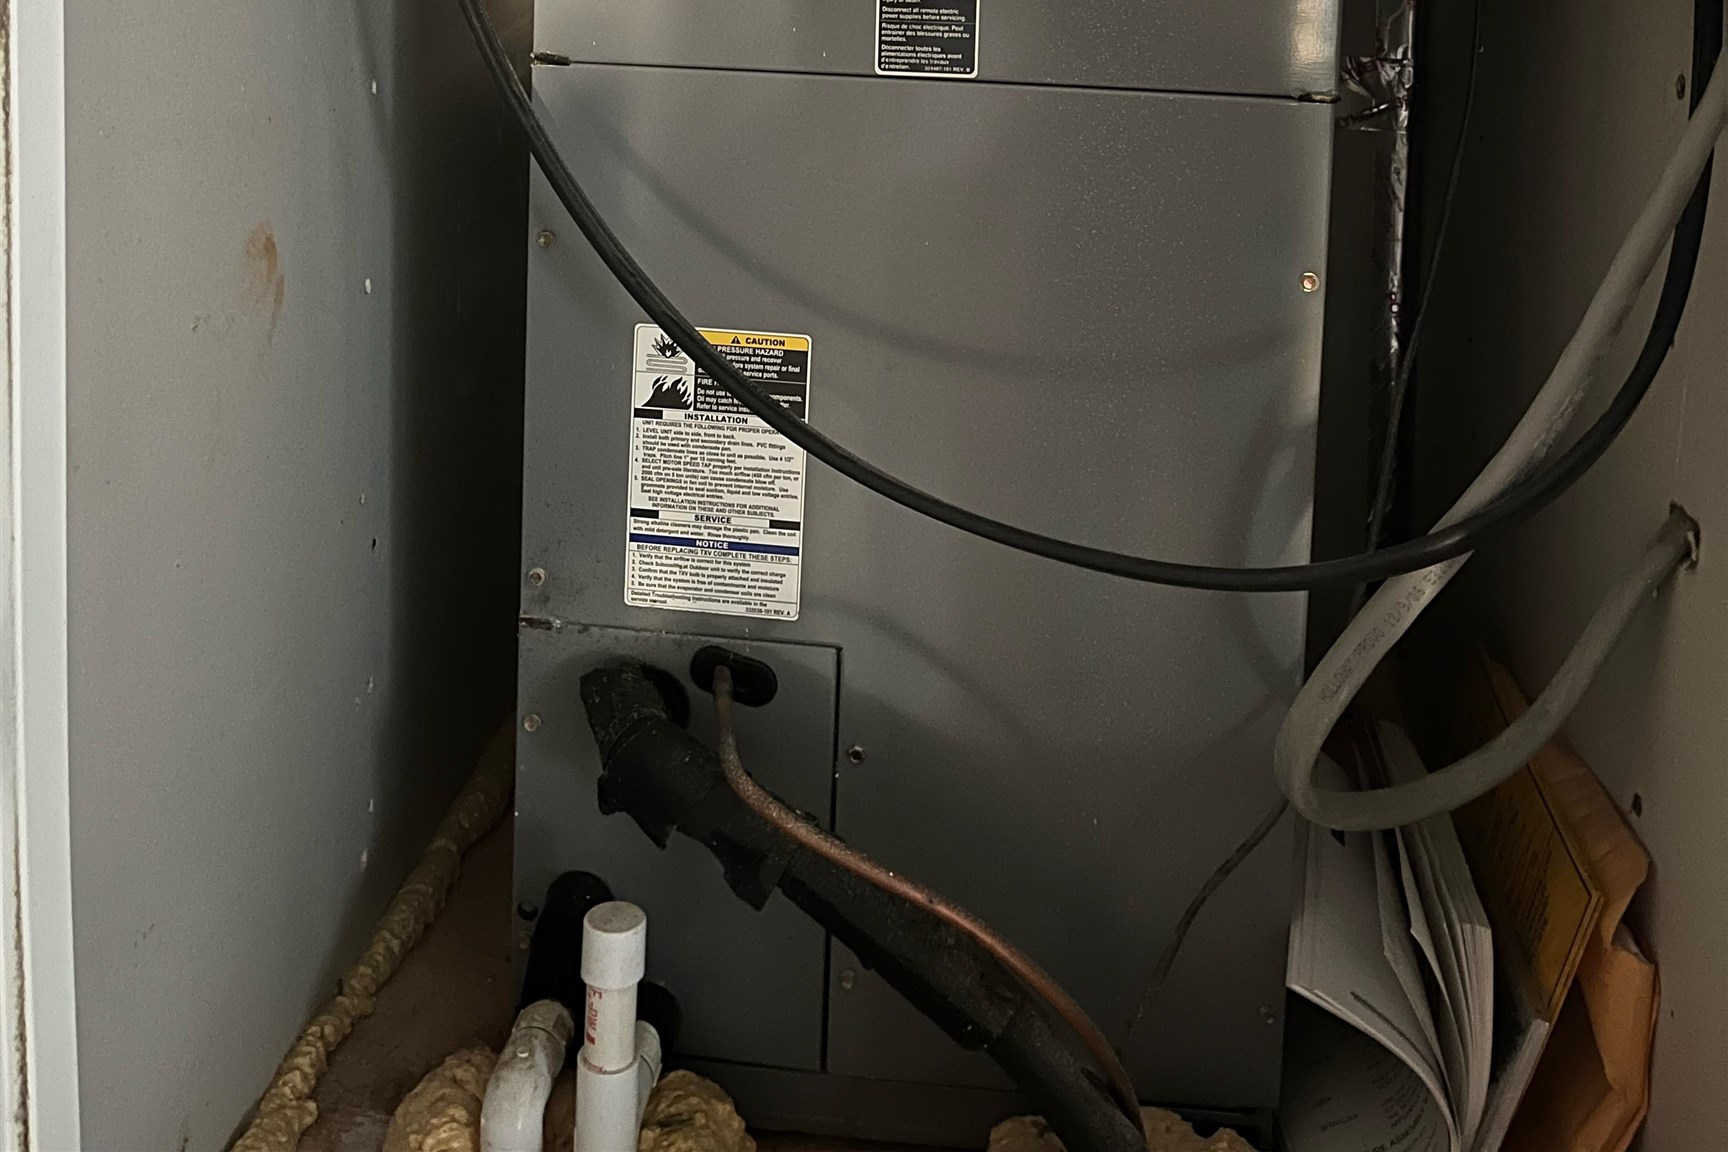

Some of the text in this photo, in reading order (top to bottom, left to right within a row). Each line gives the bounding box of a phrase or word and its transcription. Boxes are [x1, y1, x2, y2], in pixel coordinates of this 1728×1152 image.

[746, 338, 785, 346] CAUTION
[717, 345, 783, 357] PRESSURE HAZARD
[684, 413, 748, 424] INSTALLATION
[660, 497, 696, 505] INSTALLATION
[695, 514, 731, 524] SERVICE
[696, 540, 729, 548] NOTICE
